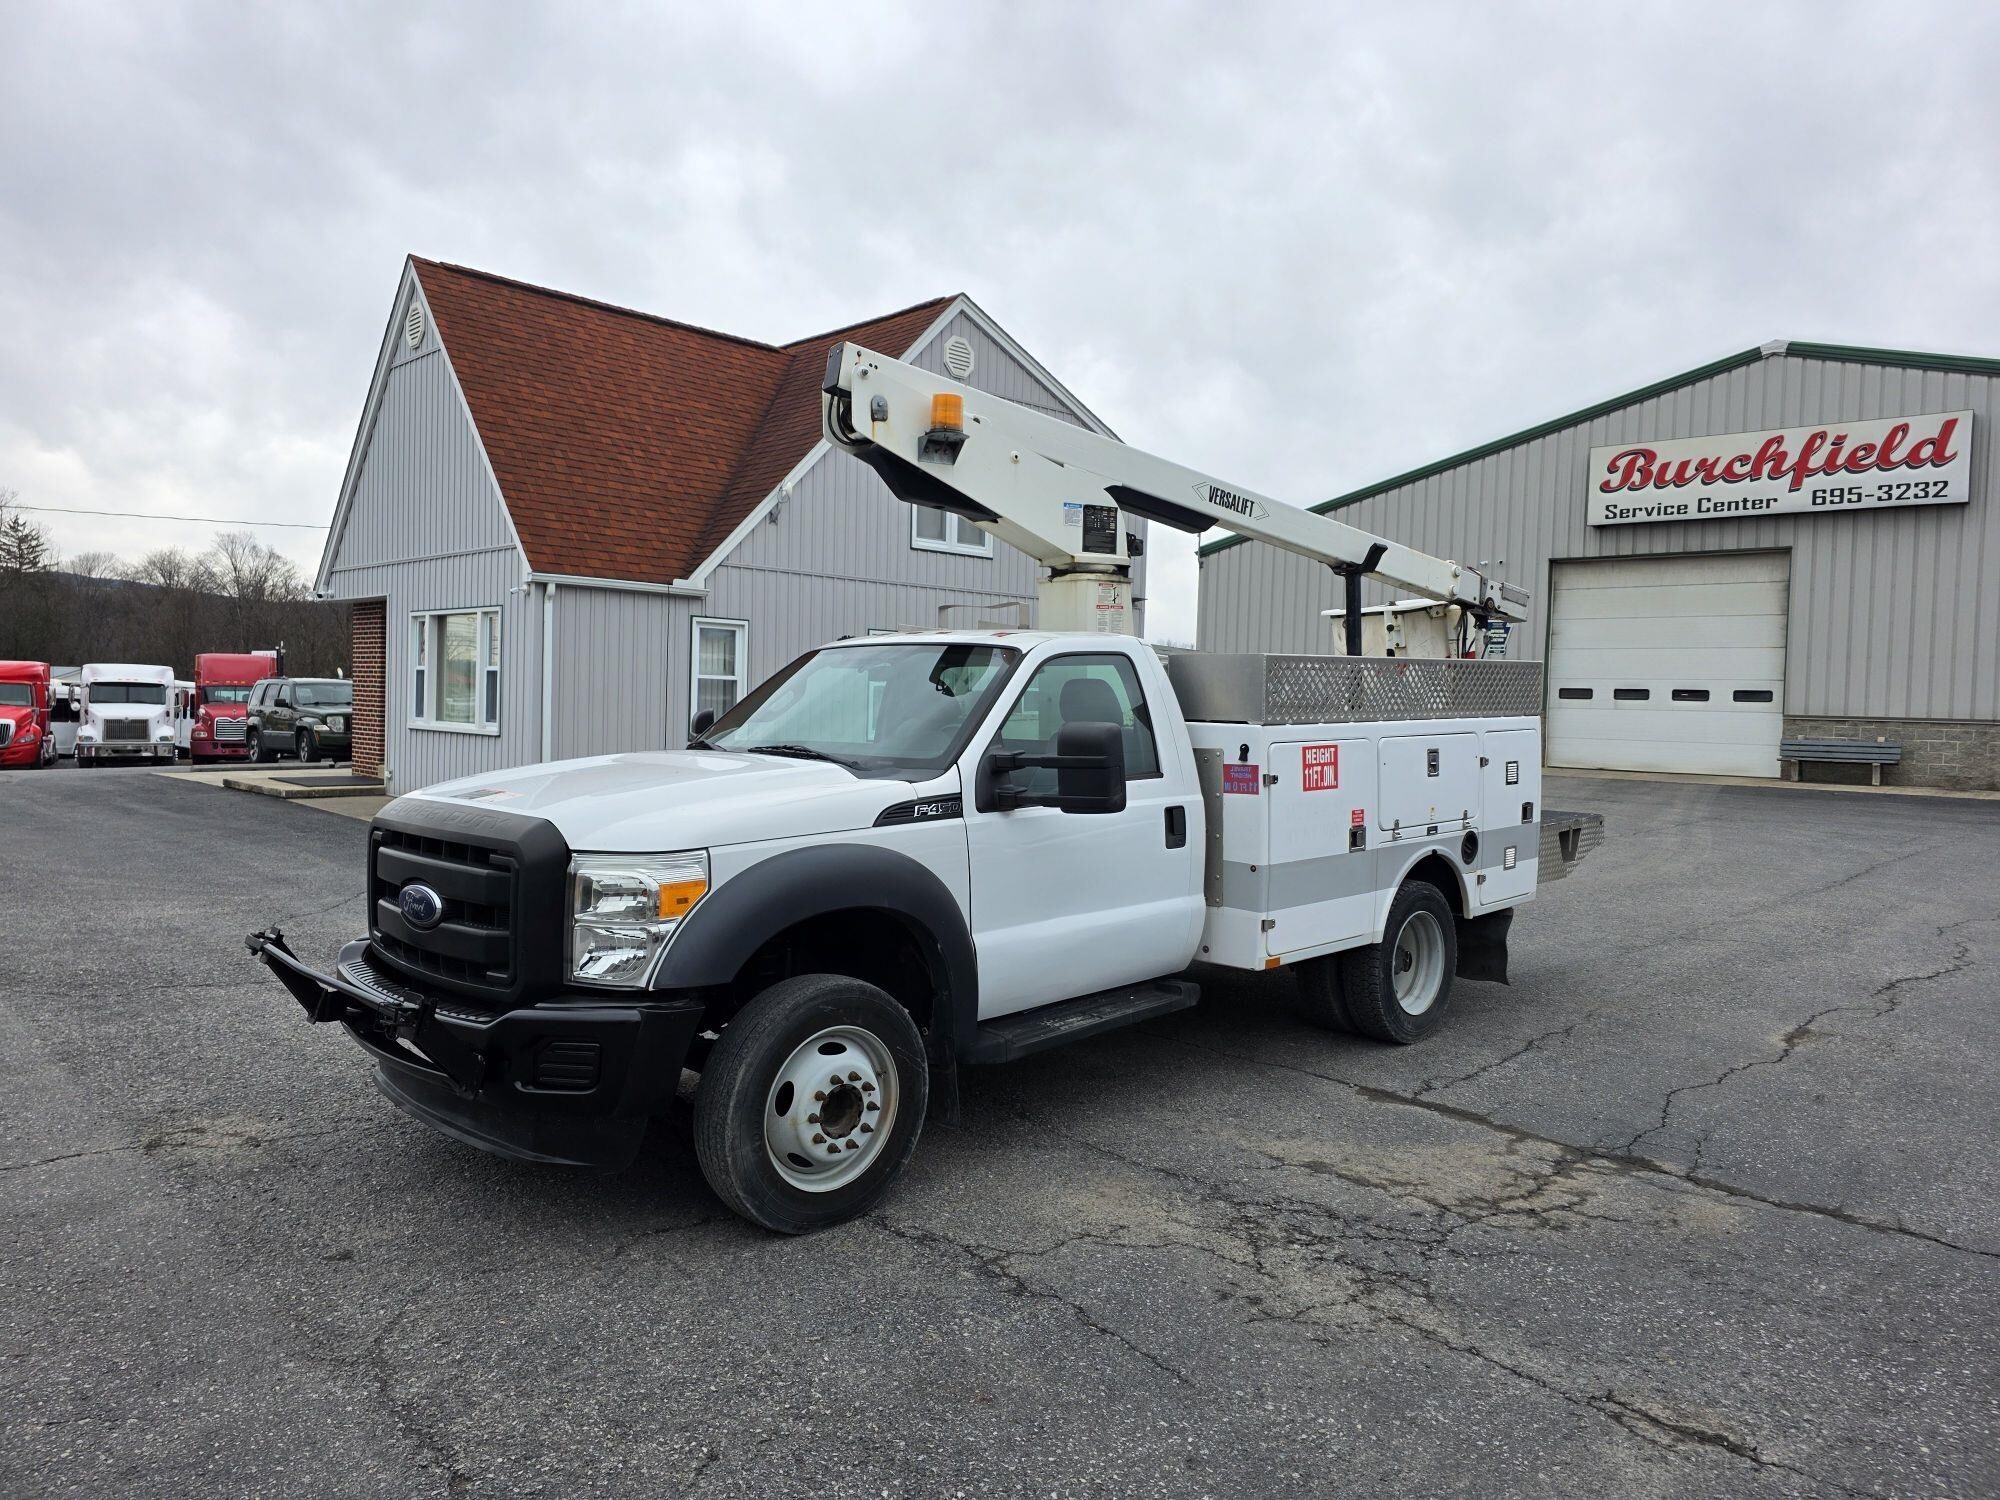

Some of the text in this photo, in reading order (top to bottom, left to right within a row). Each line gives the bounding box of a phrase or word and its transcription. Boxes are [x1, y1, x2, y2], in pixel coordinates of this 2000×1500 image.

[1599, 417, 1960, 494] Burchfield
[1208, 485, 1255, 518] VERSALIFT
[1811, 480, 1950, 507] 695-3232
[1604, 496, 1779, 521] Service Center
[1305, 747, 1336, 765] HEIGHT
[443, 810, 513, 832] DUTY
